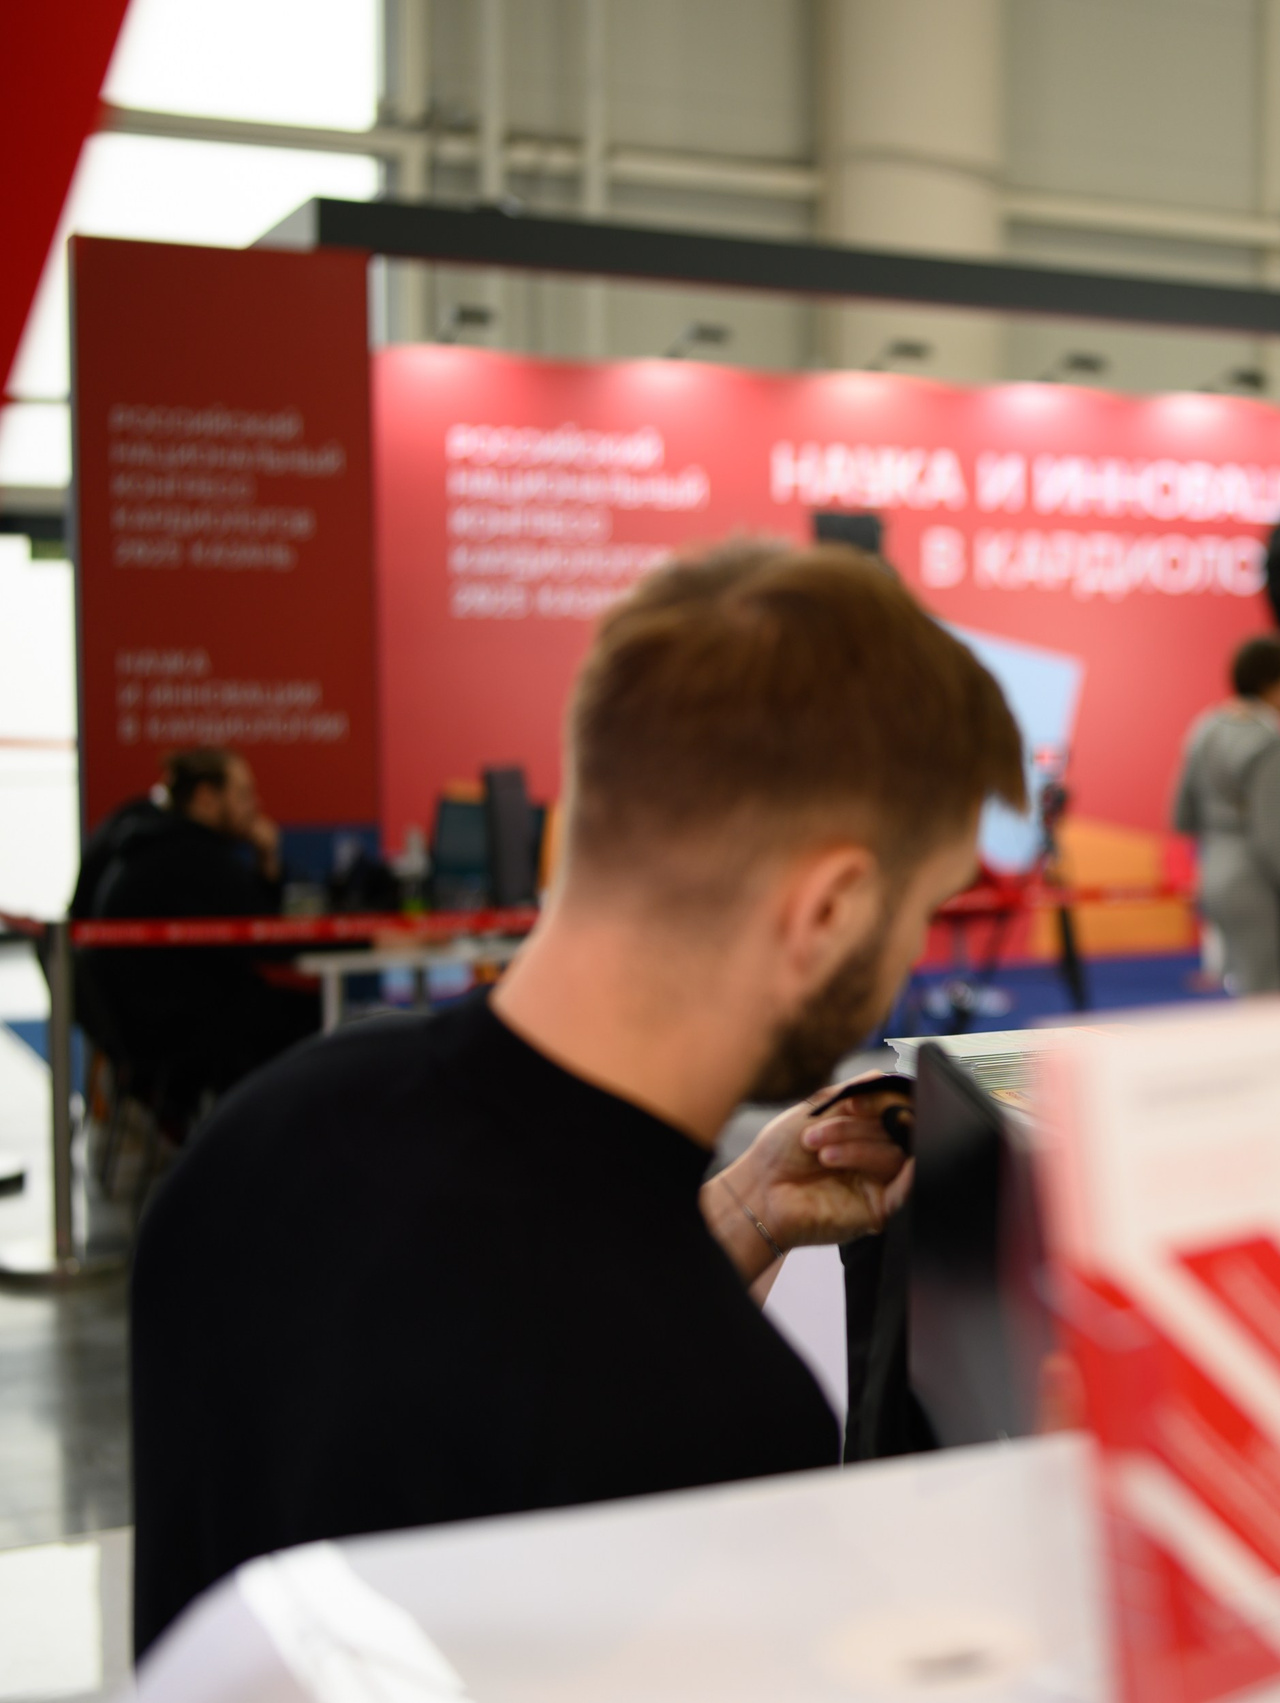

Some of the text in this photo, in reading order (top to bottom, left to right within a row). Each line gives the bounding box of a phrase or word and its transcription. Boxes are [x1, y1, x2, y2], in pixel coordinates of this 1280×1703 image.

[447, 424, 664, 470] РОССИЙСКИЙ
[771, 441, 967, 509] НАУКА
[975, 452, 1026, 512] И
[921, 526, 1268, 600] В КАРДИОЛО
